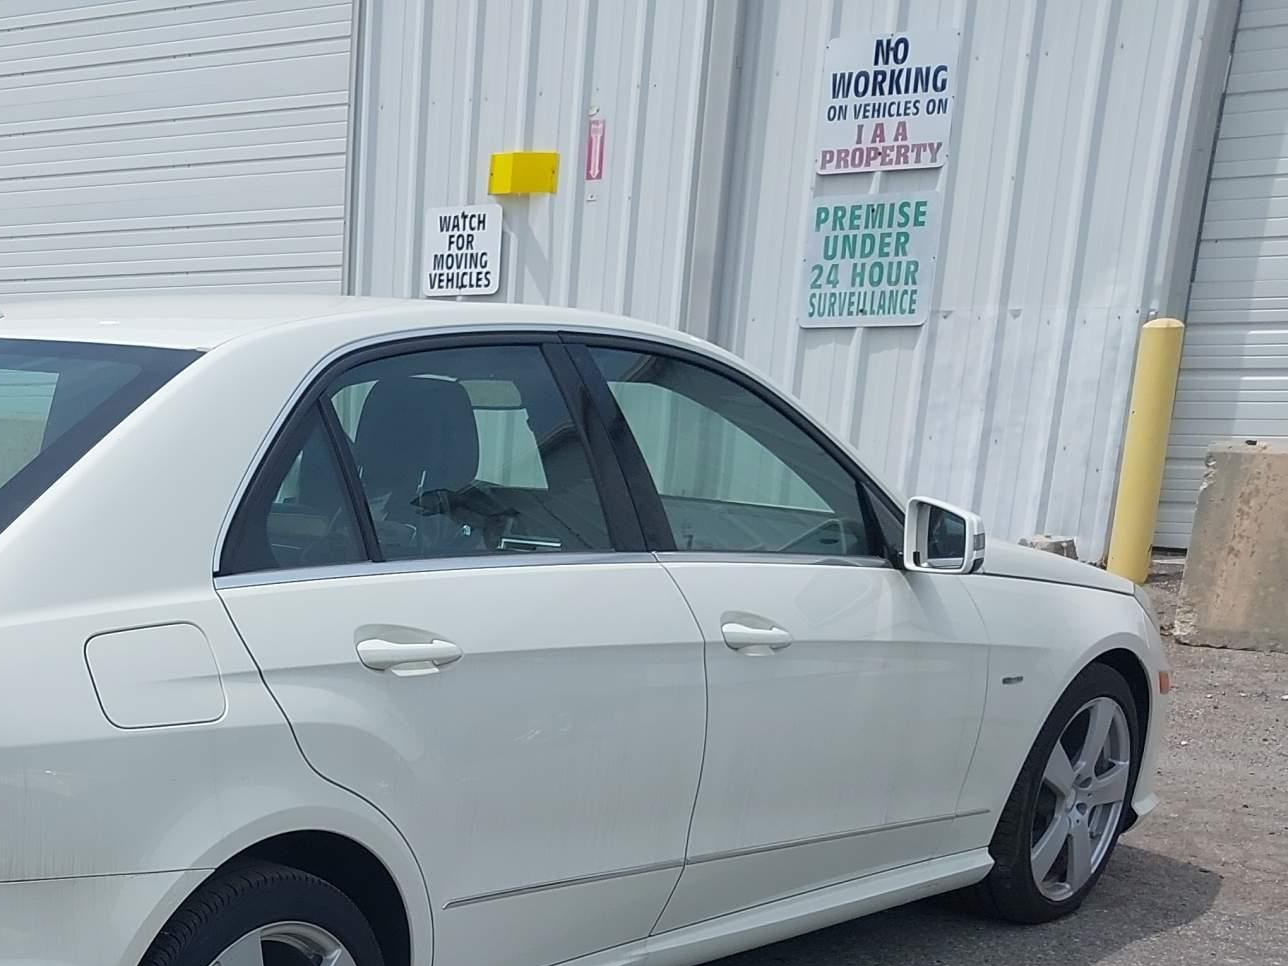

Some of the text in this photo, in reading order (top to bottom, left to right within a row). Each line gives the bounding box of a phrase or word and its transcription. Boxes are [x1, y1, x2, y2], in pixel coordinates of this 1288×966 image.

[874, 37, 910, 66] NO
[831, 65, 948, 99] WORKING
[827, 98, 948, 121] ON VEHICLES ON
[820, 142, 942, 170] PROPERTY
[439, 213, 486, 232] WATCH
[815, 201, 927, 232] PREMISE
[448, 234, 474, 251] FOR
[823, 231, 910, 261] UNDER
[433, 252, 488, 271] MOVING
[810, 260, 919, 290] 24 HOUR
[429, 271, 491, 289] VEHICLES
[808, 289, 918, 318] SURVEILLANCE
